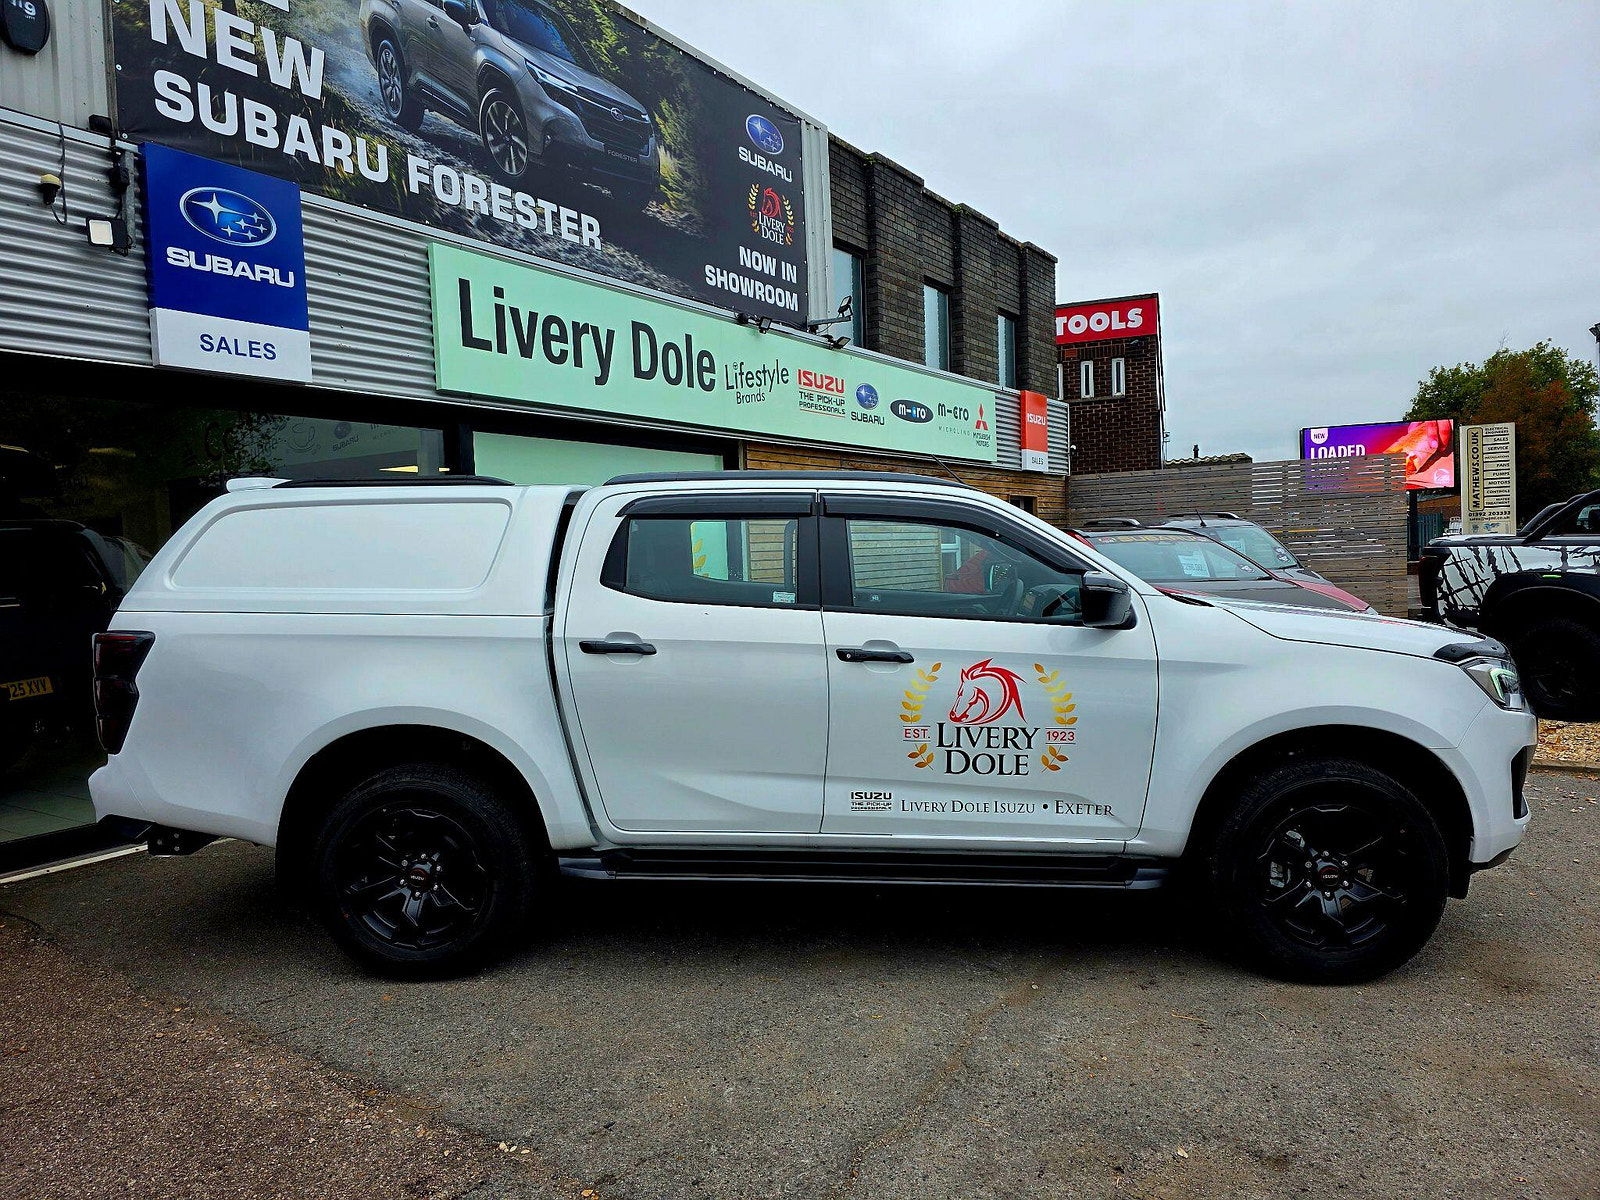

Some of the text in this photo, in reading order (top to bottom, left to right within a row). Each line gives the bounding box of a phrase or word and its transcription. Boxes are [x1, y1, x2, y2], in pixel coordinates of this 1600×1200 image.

[149, 0, 325, 100] NEW
[153, 69, 602, 251] SUBARU FORESTER
[607, 149, 638, 163] FORESTER
[738, 146, 793, 183] SUBARU
[758, 211, 786, 234] LIVERY
[761, 224, 784, 246] DOLE
[166, 246, 295, 288] SUBARU
[739, 245, 798, 284] NOW IN
[704, 264, 799, 312] SHOWROOM
[1056, 307, 1143, 336] TOOLS
[458, 277, 716, 392] Livery Dole
[199, 333, 277, 361] SALES
[724, 359, 789, 393] Lifestyle
[797, 368, 845, 394] ISUZU
[736, 388, 766, 405] Brands
[798, 390, 845, 407] THE PICK-UP
[798, 400, 846, 415] PROFESSIONALS
[850, 411, 885, 426] SUBARU
[1027, 413, 1046, 426] ISUZU
[1313, 432, 1326, 440] NEW
[1031, 456, 1044, 466] SALES
[1471, 431, 1480, 508] MATHEWS.CO.UK
[904, 728, 931, 740] EST.
[936, 722, 1041, 751] LIVERY
[1046, 730, 1075, 742] 1923
[944, 750, 1029, 776] DOLE
[850, 792, 892, 800] ISUZU
[901, 800, 1114, 816] LIVERY DOLE ISUZU EXETER
